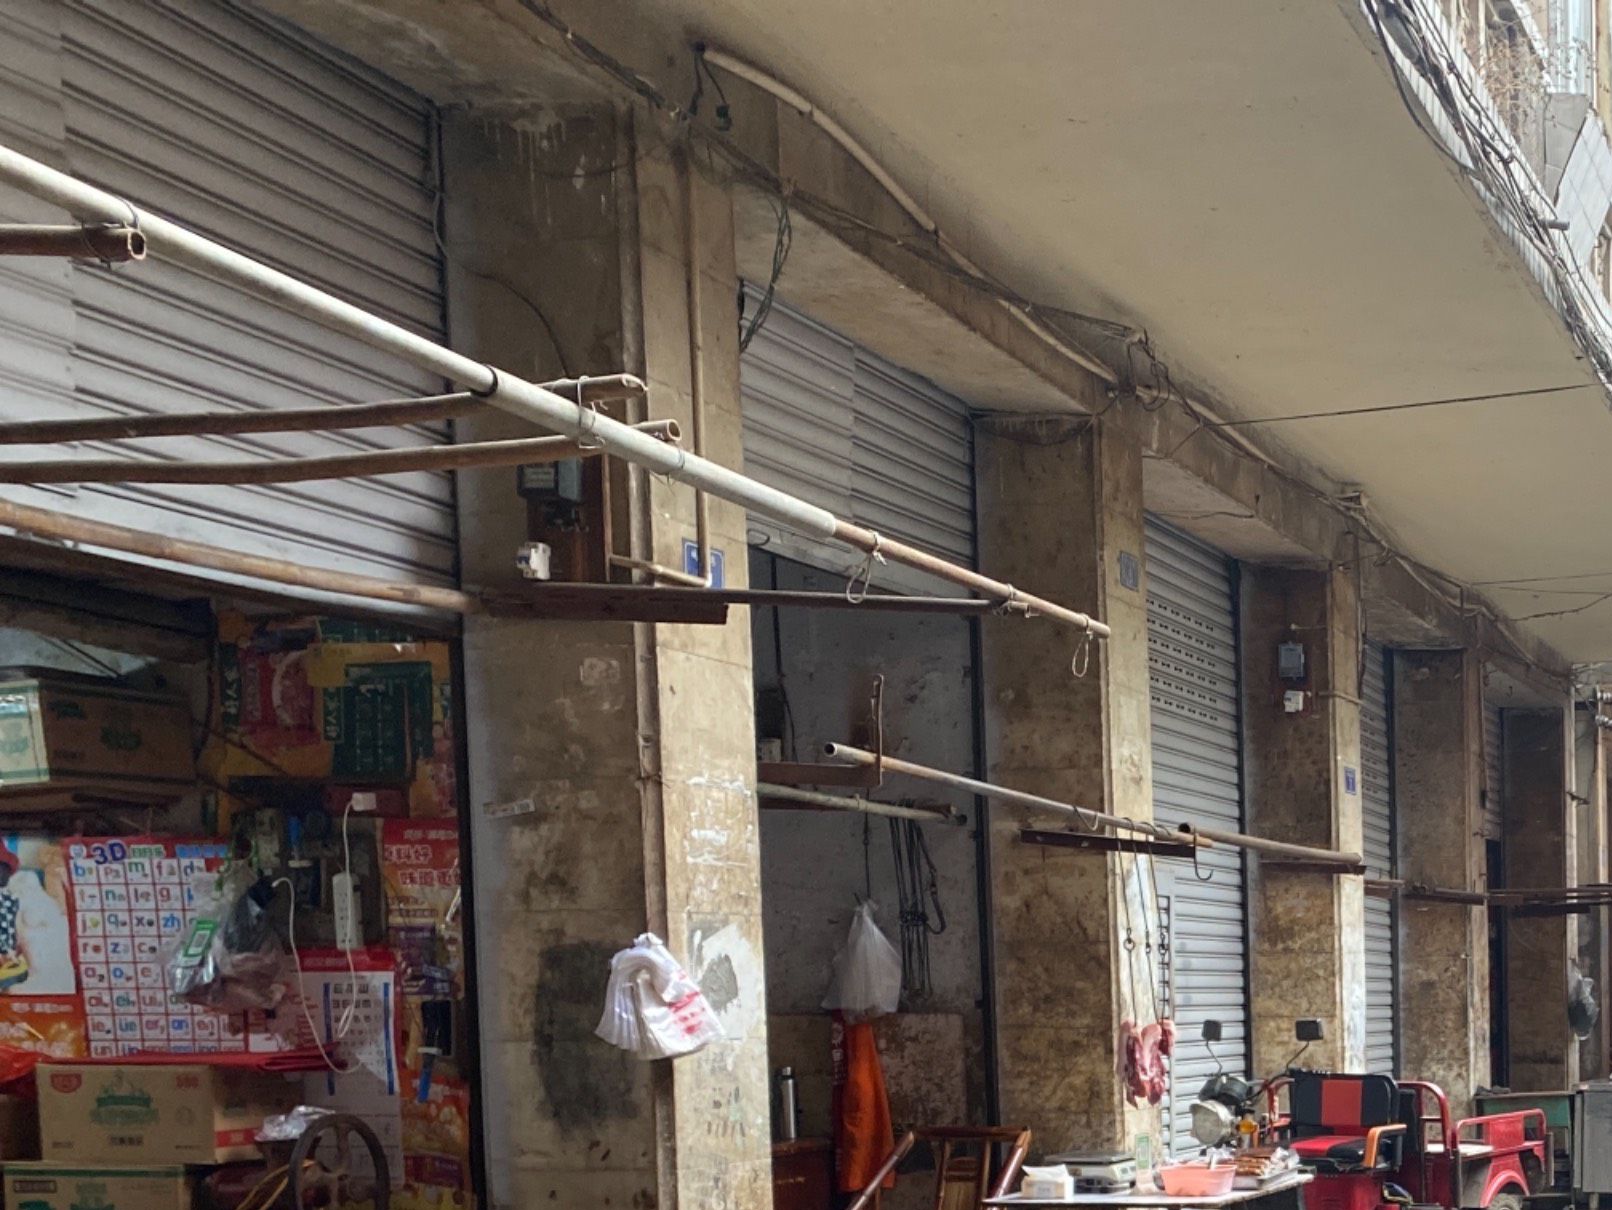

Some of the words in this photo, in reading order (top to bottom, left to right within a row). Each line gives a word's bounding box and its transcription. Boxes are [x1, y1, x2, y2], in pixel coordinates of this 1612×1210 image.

[93, 842, 127, 865] 3D
[74, 862, 86, 877] b
[129, 862, 145, 873] m
[106, 888, 117, 901] n
[135, 915, 146, 927] x
[111, 942, 121, 954] z
